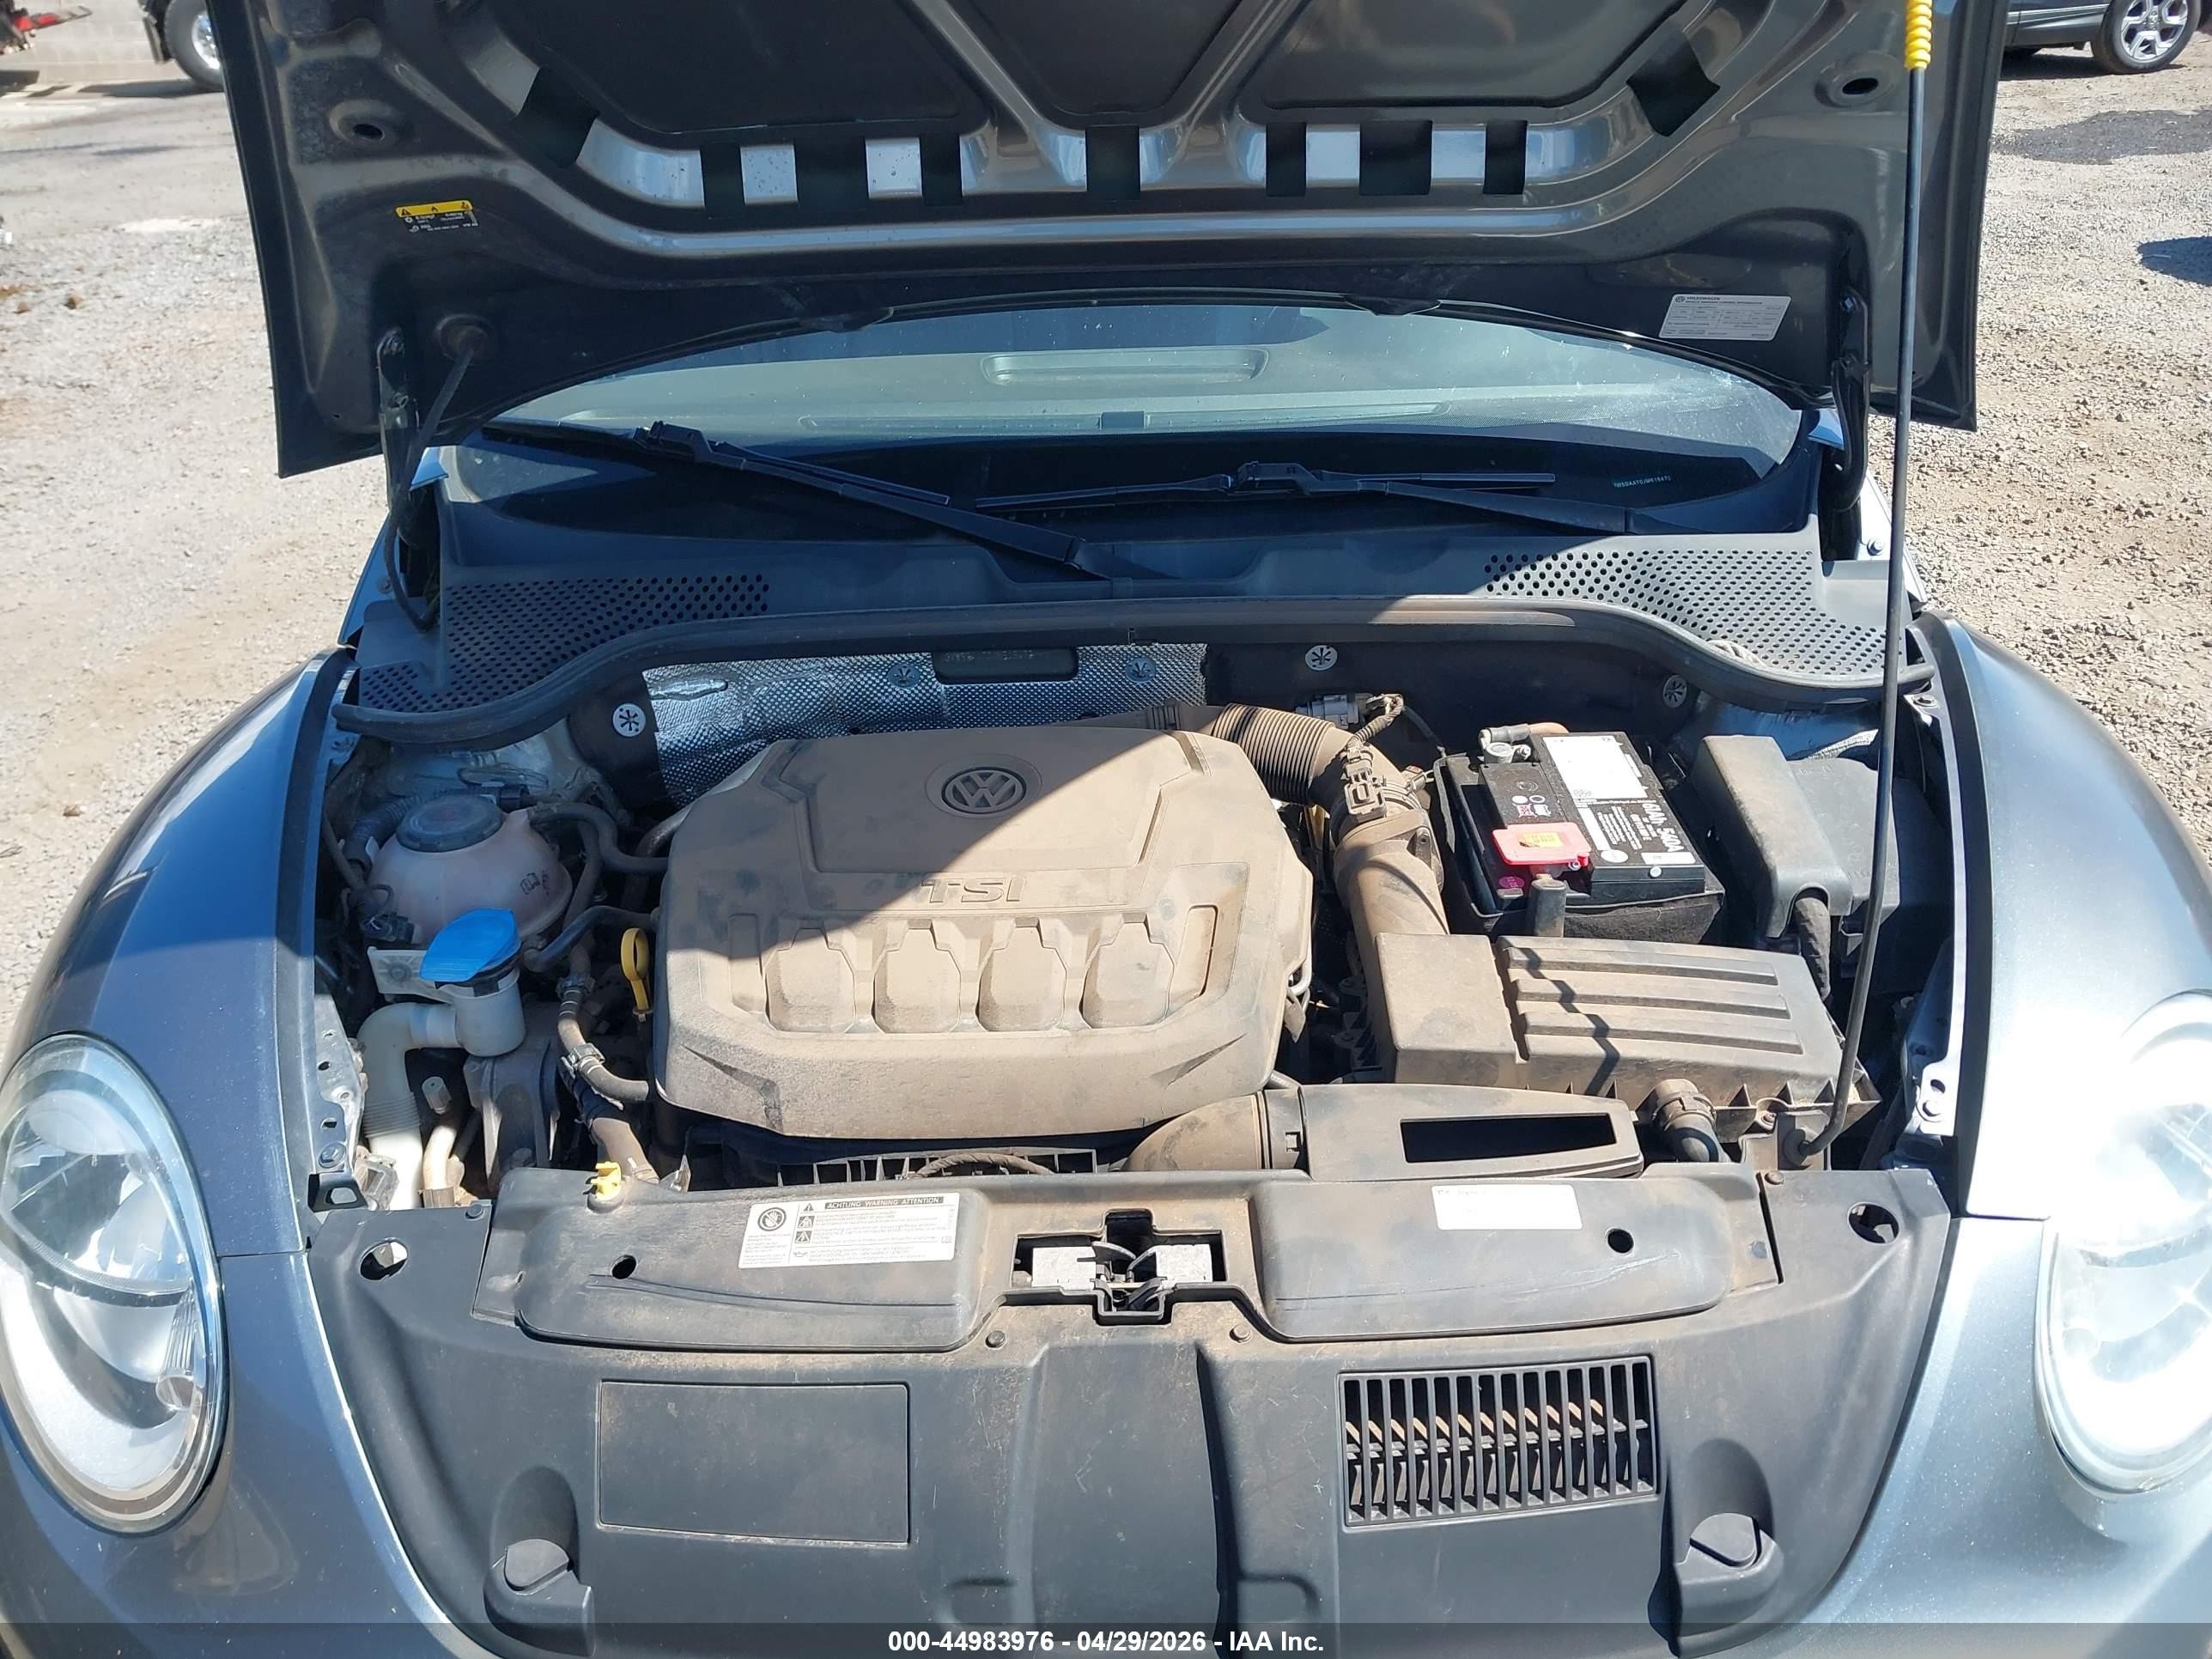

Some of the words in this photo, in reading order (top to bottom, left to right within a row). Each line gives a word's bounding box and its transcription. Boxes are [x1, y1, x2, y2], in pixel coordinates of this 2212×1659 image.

[943, 767, 1025, 813] VW
[921, 878, 1027, 903] TSI
[865, 1199, 899, 1207] WARNING
